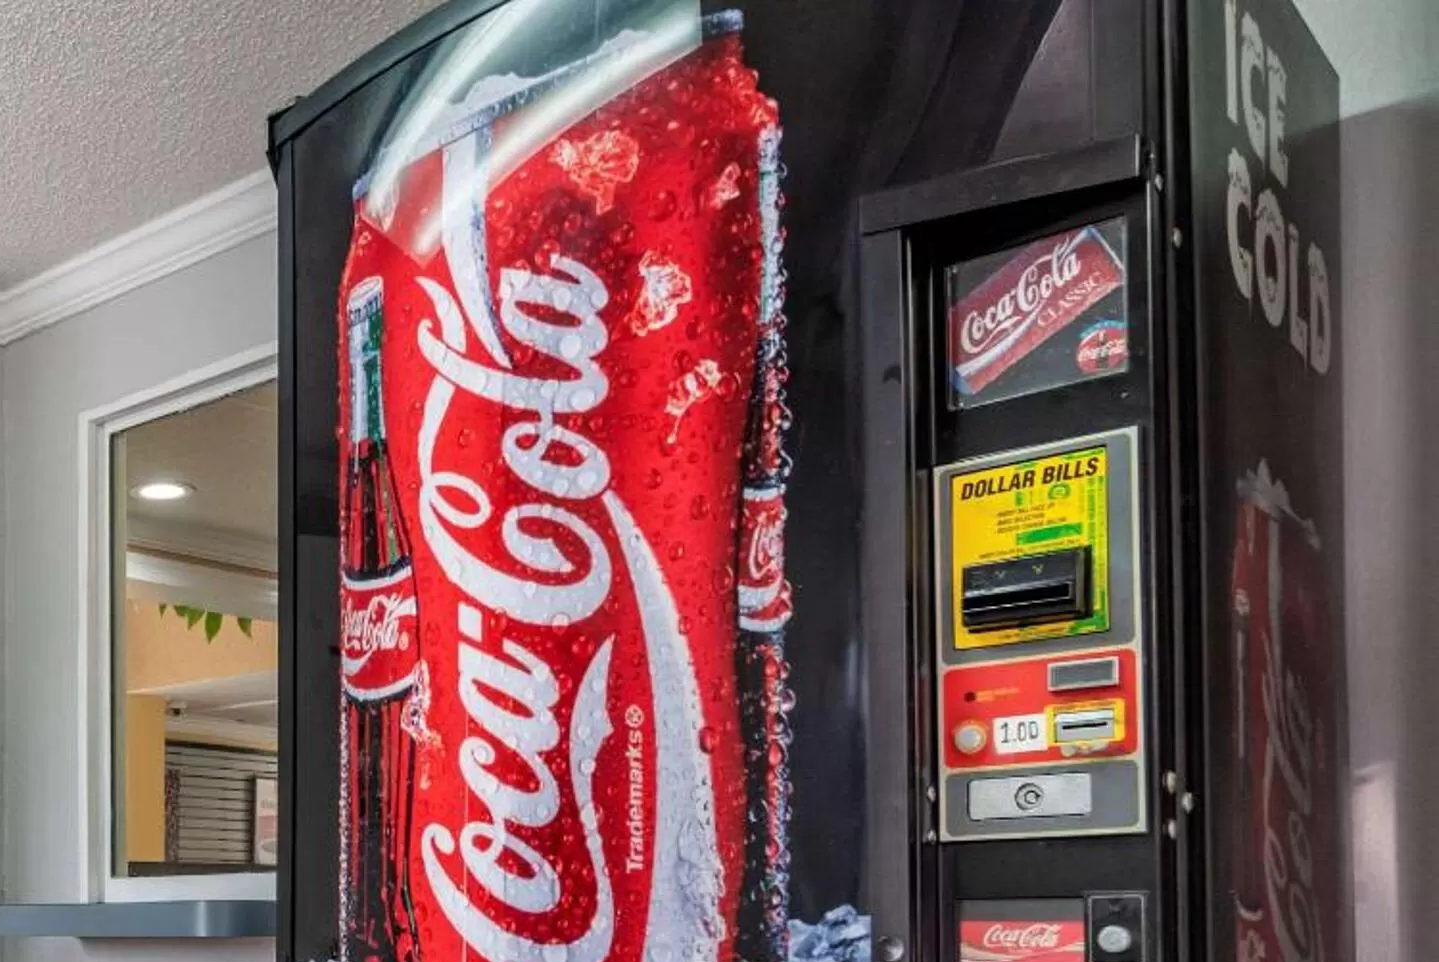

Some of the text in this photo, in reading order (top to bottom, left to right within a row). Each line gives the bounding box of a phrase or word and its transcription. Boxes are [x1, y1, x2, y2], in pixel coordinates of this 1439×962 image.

[1224, 0, 1289, 190] ICE
[962, 237, 1082, 354] Coca-Cola
[1226, 147, 1331, 376] COLD
[961, 456, 1100, 500] DOLLAR BILLS
[1000, 720, 1039, 744] 1.00
[983, 924, 1063, 949] Coca-Cola
